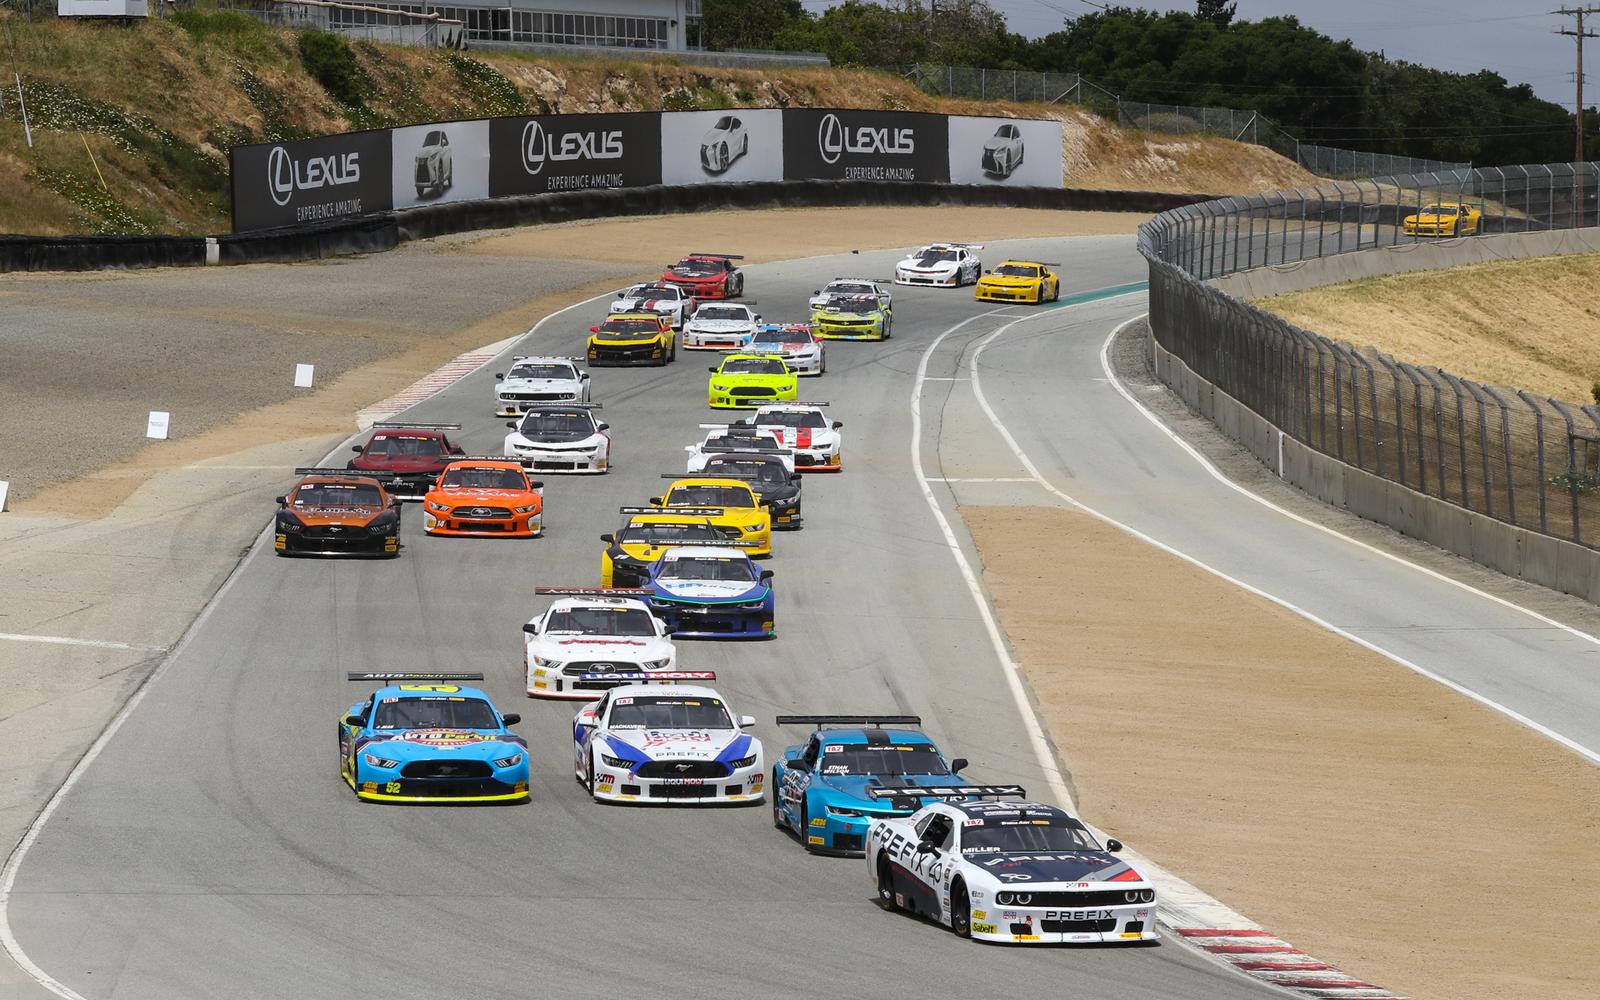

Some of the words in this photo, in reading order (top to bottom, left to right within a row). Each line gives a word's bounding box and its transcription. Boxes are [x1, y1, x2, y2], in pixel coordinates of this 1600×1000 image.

[547, 130, 623, 161] LEXUS
[845, 126, 914, 154] LEXUS
[294, 152, 360, 190] LEXUS
[845, 167, 884, 180] EXPERIENCE
[885, 167, 915, 180] AMAZING
[547, 175, 589, 190] EXPERIENCE
[590, 173, 623, 187] AMAZING
[297, 202, 334, 222] EXPERIENCE
[335, 198, 362, 216] AMAZING
[584, 672, 646, 680] LIQUI
[648, 671, 712, 680] MOLY
[386, 781, 401, 794] 52
[872, 822, 929, 876] PREFIX
[928, 862, 943, 886] 40
[1045, 910, 1115, 920] PREFIX
[972, 922, 995, 934] Sabelt
